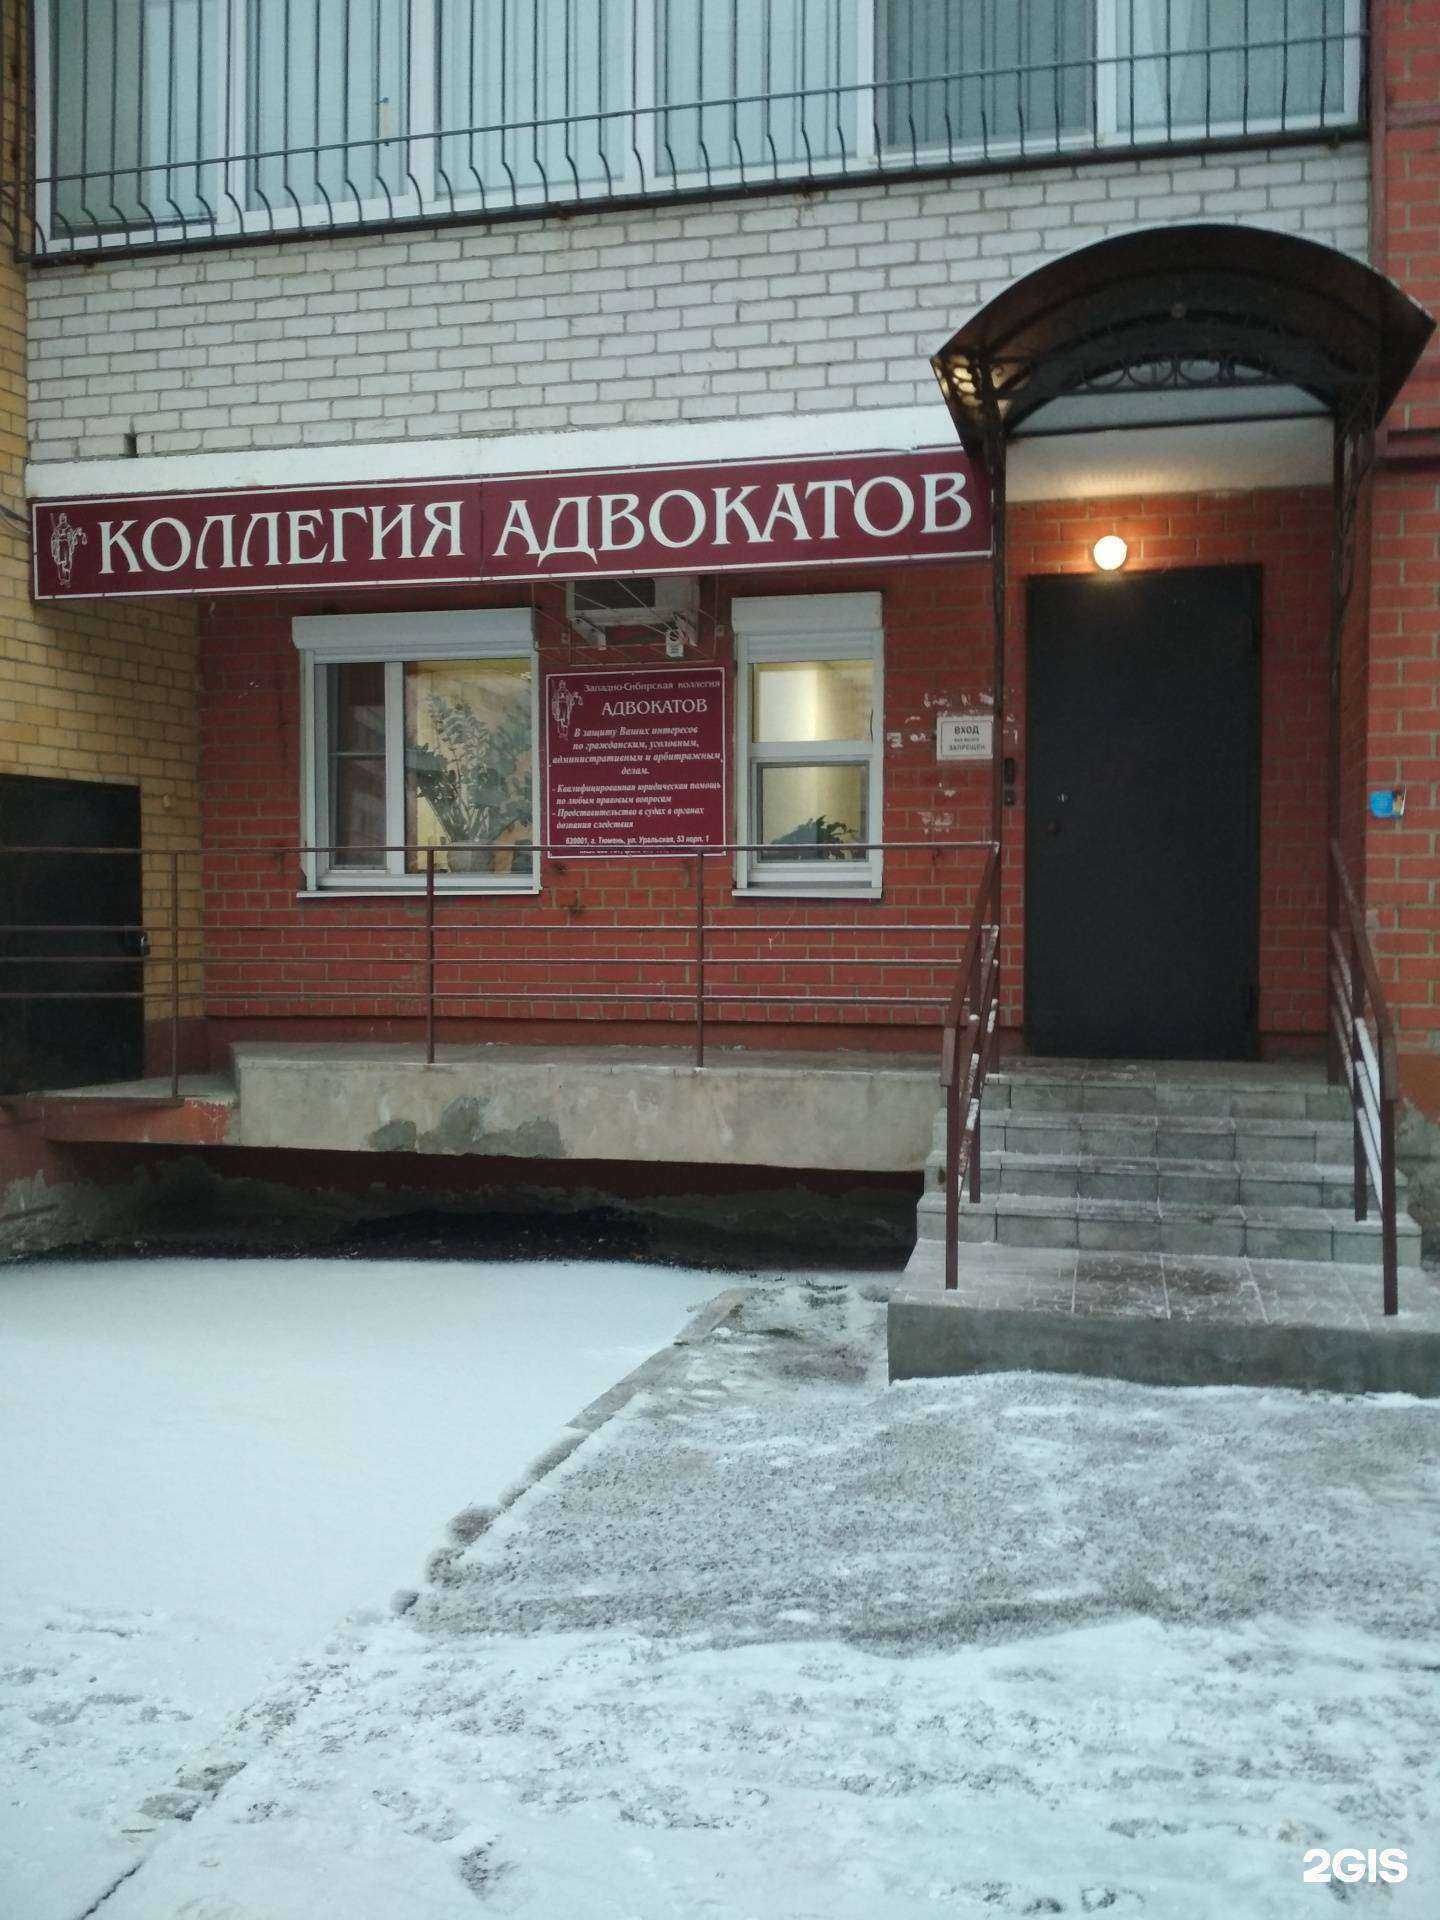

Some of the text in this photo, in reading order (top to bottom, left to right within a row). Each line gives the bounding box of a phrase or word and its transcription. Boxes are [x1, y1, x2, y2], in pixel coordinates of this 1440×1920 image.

[98, 472, 972, 574] КОЛЛЕГИЯ АДВОКАТОВ
[583, 681, 673, 693] Западно-Сибирская
[602, 698, 708, 716] АДВОКАТОВ
[574, 726, 698, 738] В защиту Ваших интересов
[954, 725, 980, 735] ВХОД
[585, 741, 648, 752] гражданским,
[552, 755, 643, 765] административным
[653, 752, 721, 763] арбитражным
[621, 767, 650, 776] делам.
